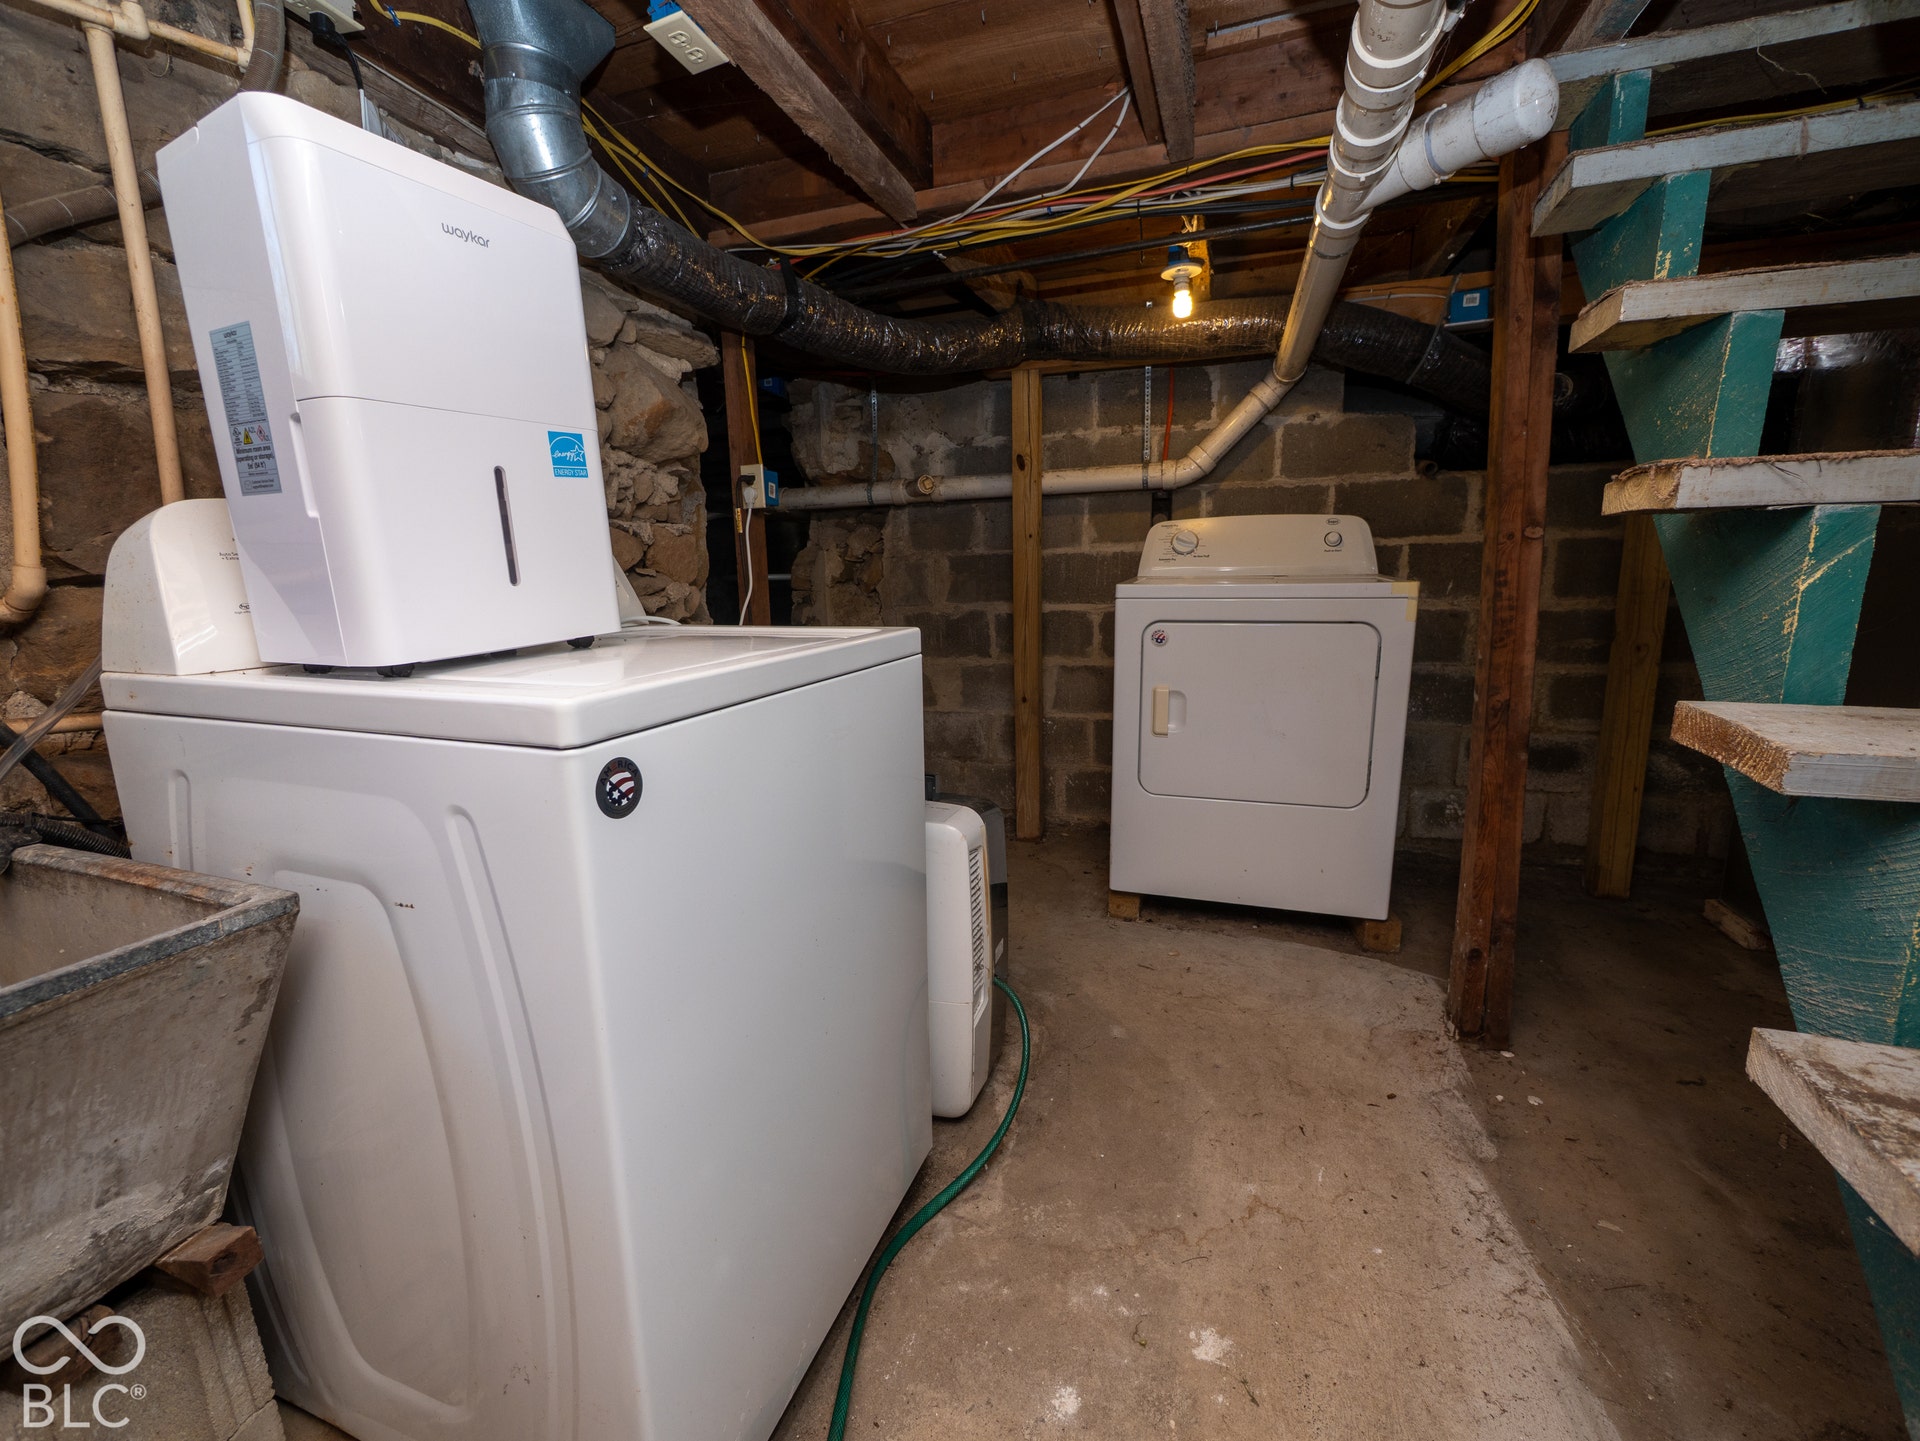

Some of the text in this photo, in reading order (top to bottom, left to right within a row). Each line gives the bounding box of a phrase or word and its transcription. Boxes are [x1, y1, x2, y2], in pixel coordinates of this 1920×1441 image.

[441, 222, 490, 248] waykar
[554, 468, 588, 477] ENERGY STAR
